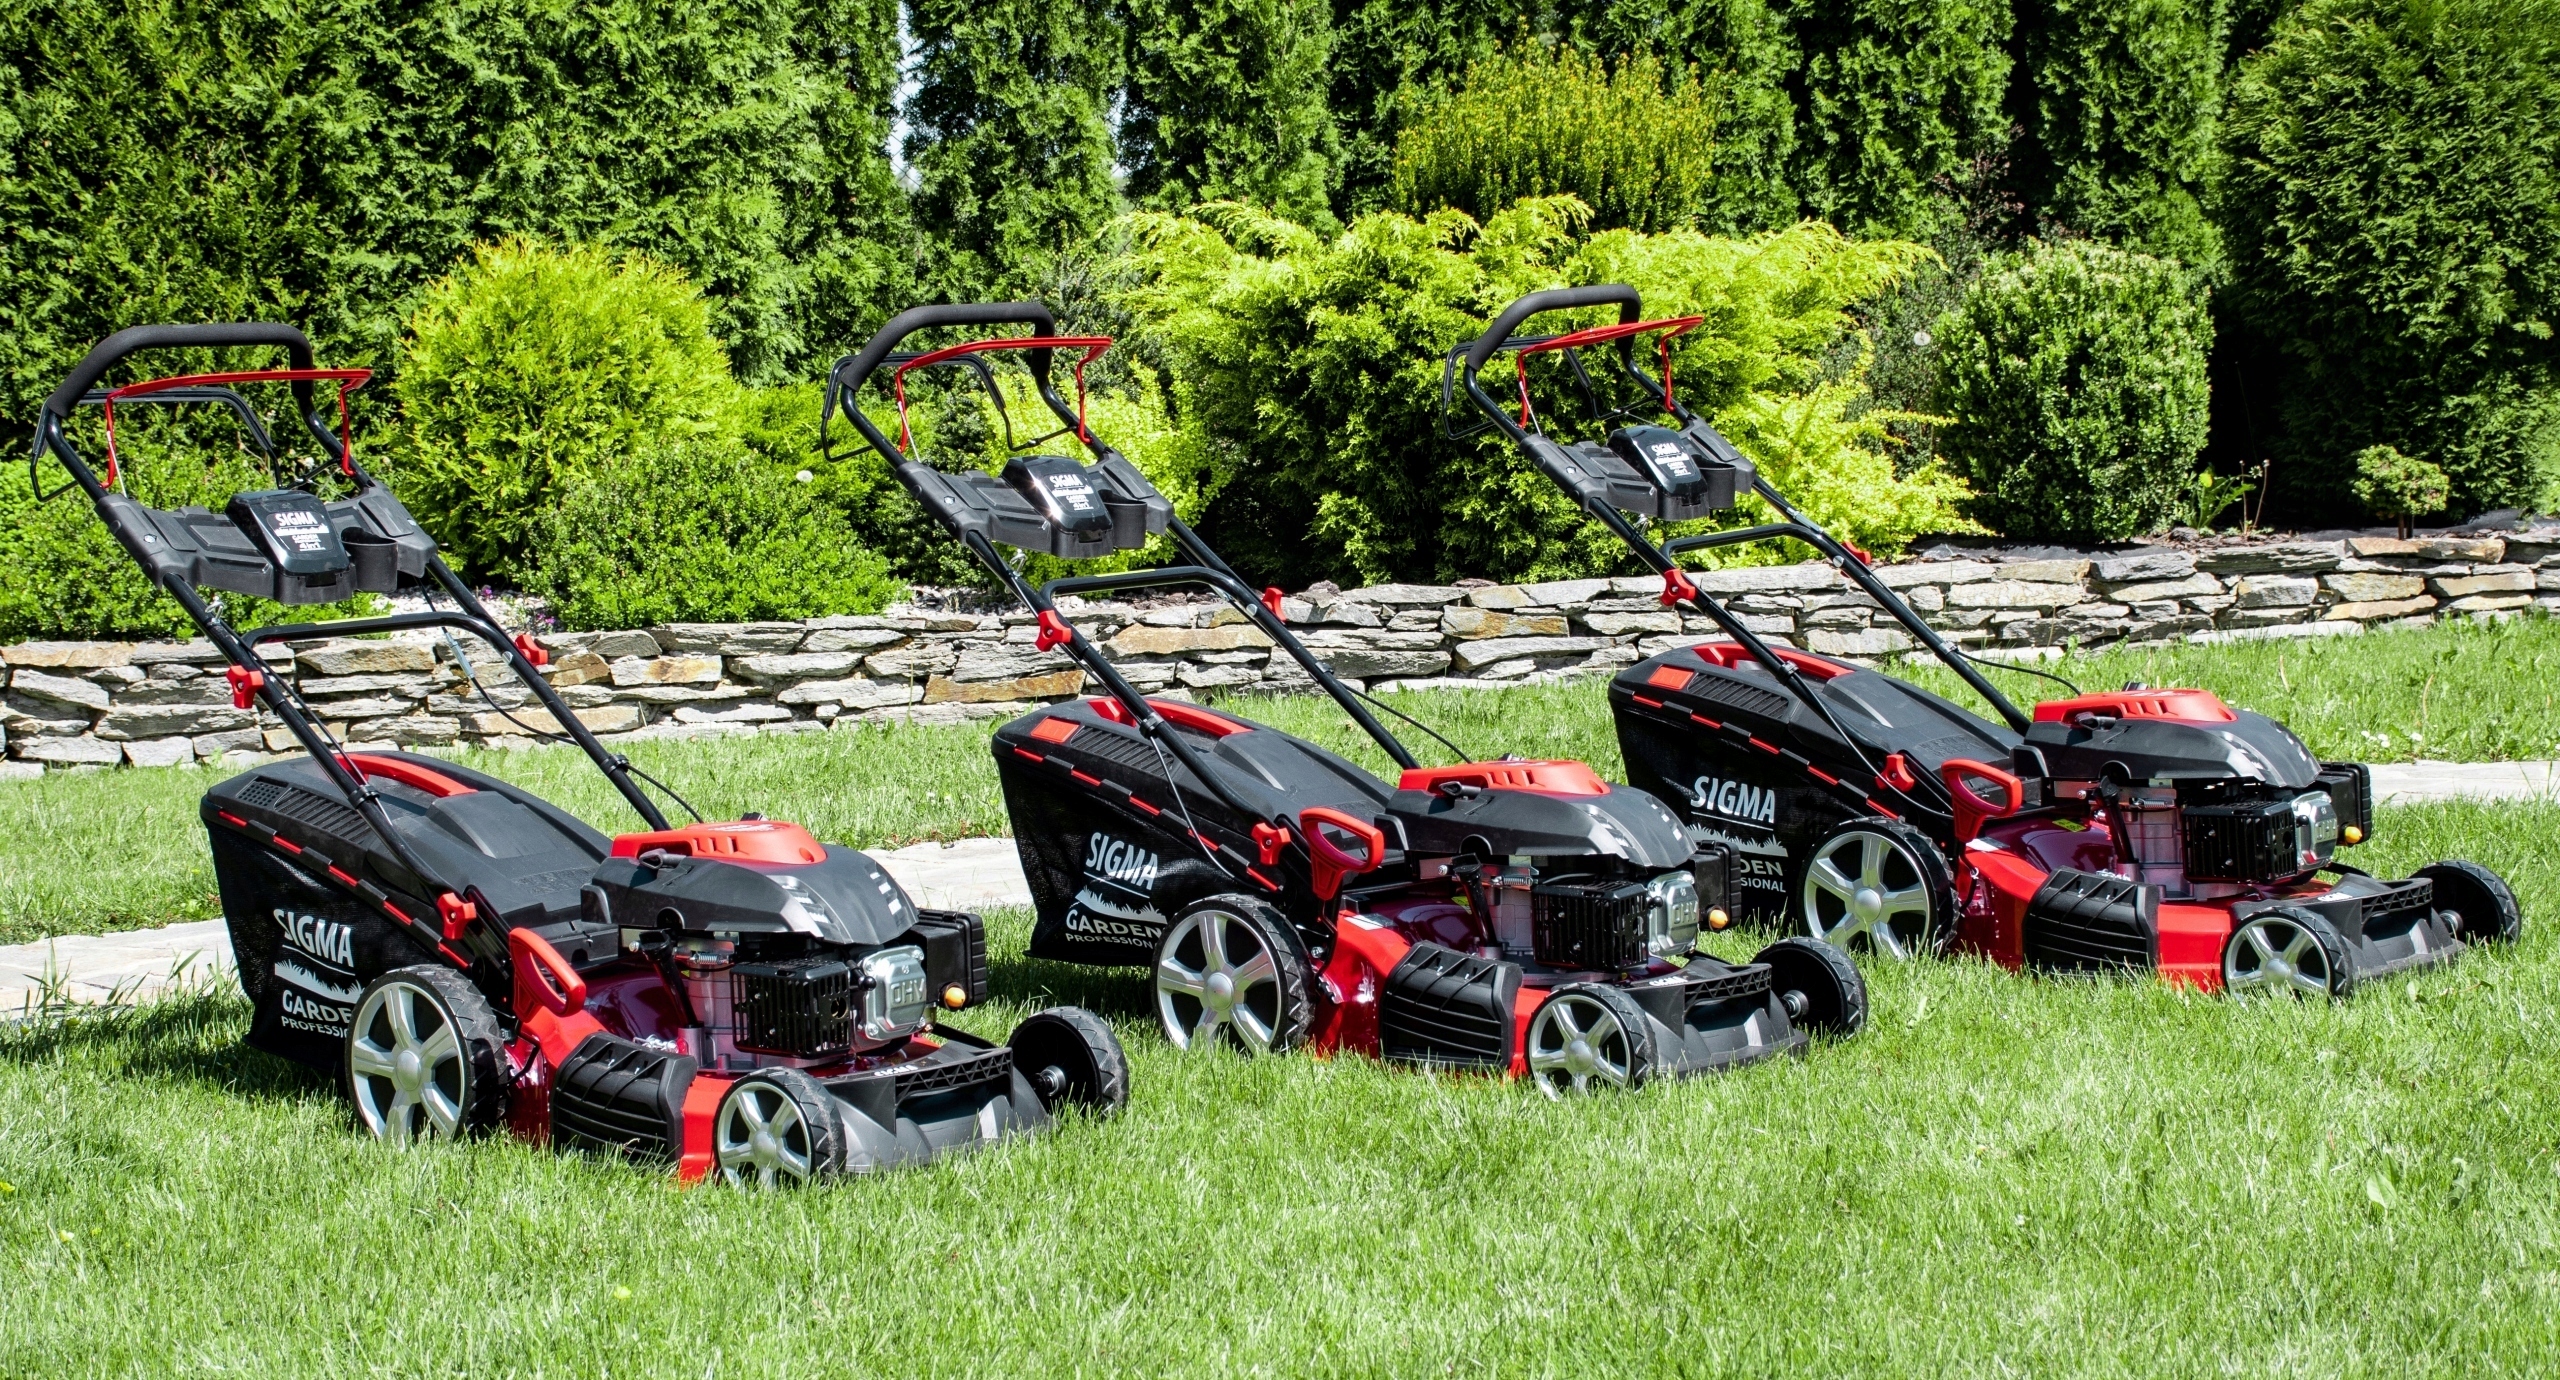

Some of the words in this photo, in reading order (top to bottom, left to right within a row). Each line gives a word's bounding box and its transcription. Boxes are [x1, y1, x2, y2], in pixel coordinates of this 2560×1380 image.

[1049, 474, 1083, 488] SIGMA
[275, 511, 318, 526] SIGMA
[1690, 775, 1776, 824] SIGMA
[1085, 831, 1158, 891] SIGMA
[1740, 858, 1784, 876] DEN
[1740, 877, 1787, 893] SIONAL
[1066, 909, 1162, 939] GARDEN
[273, 908, 355, 968] SIGMA
[1065, 932, 1157, 950] PROFESSION
[890, 977, 926, 1003] OHV
[282, 989, 352, 1024] GARDE
[281, 1015, 347, 1039] PROFESSI
